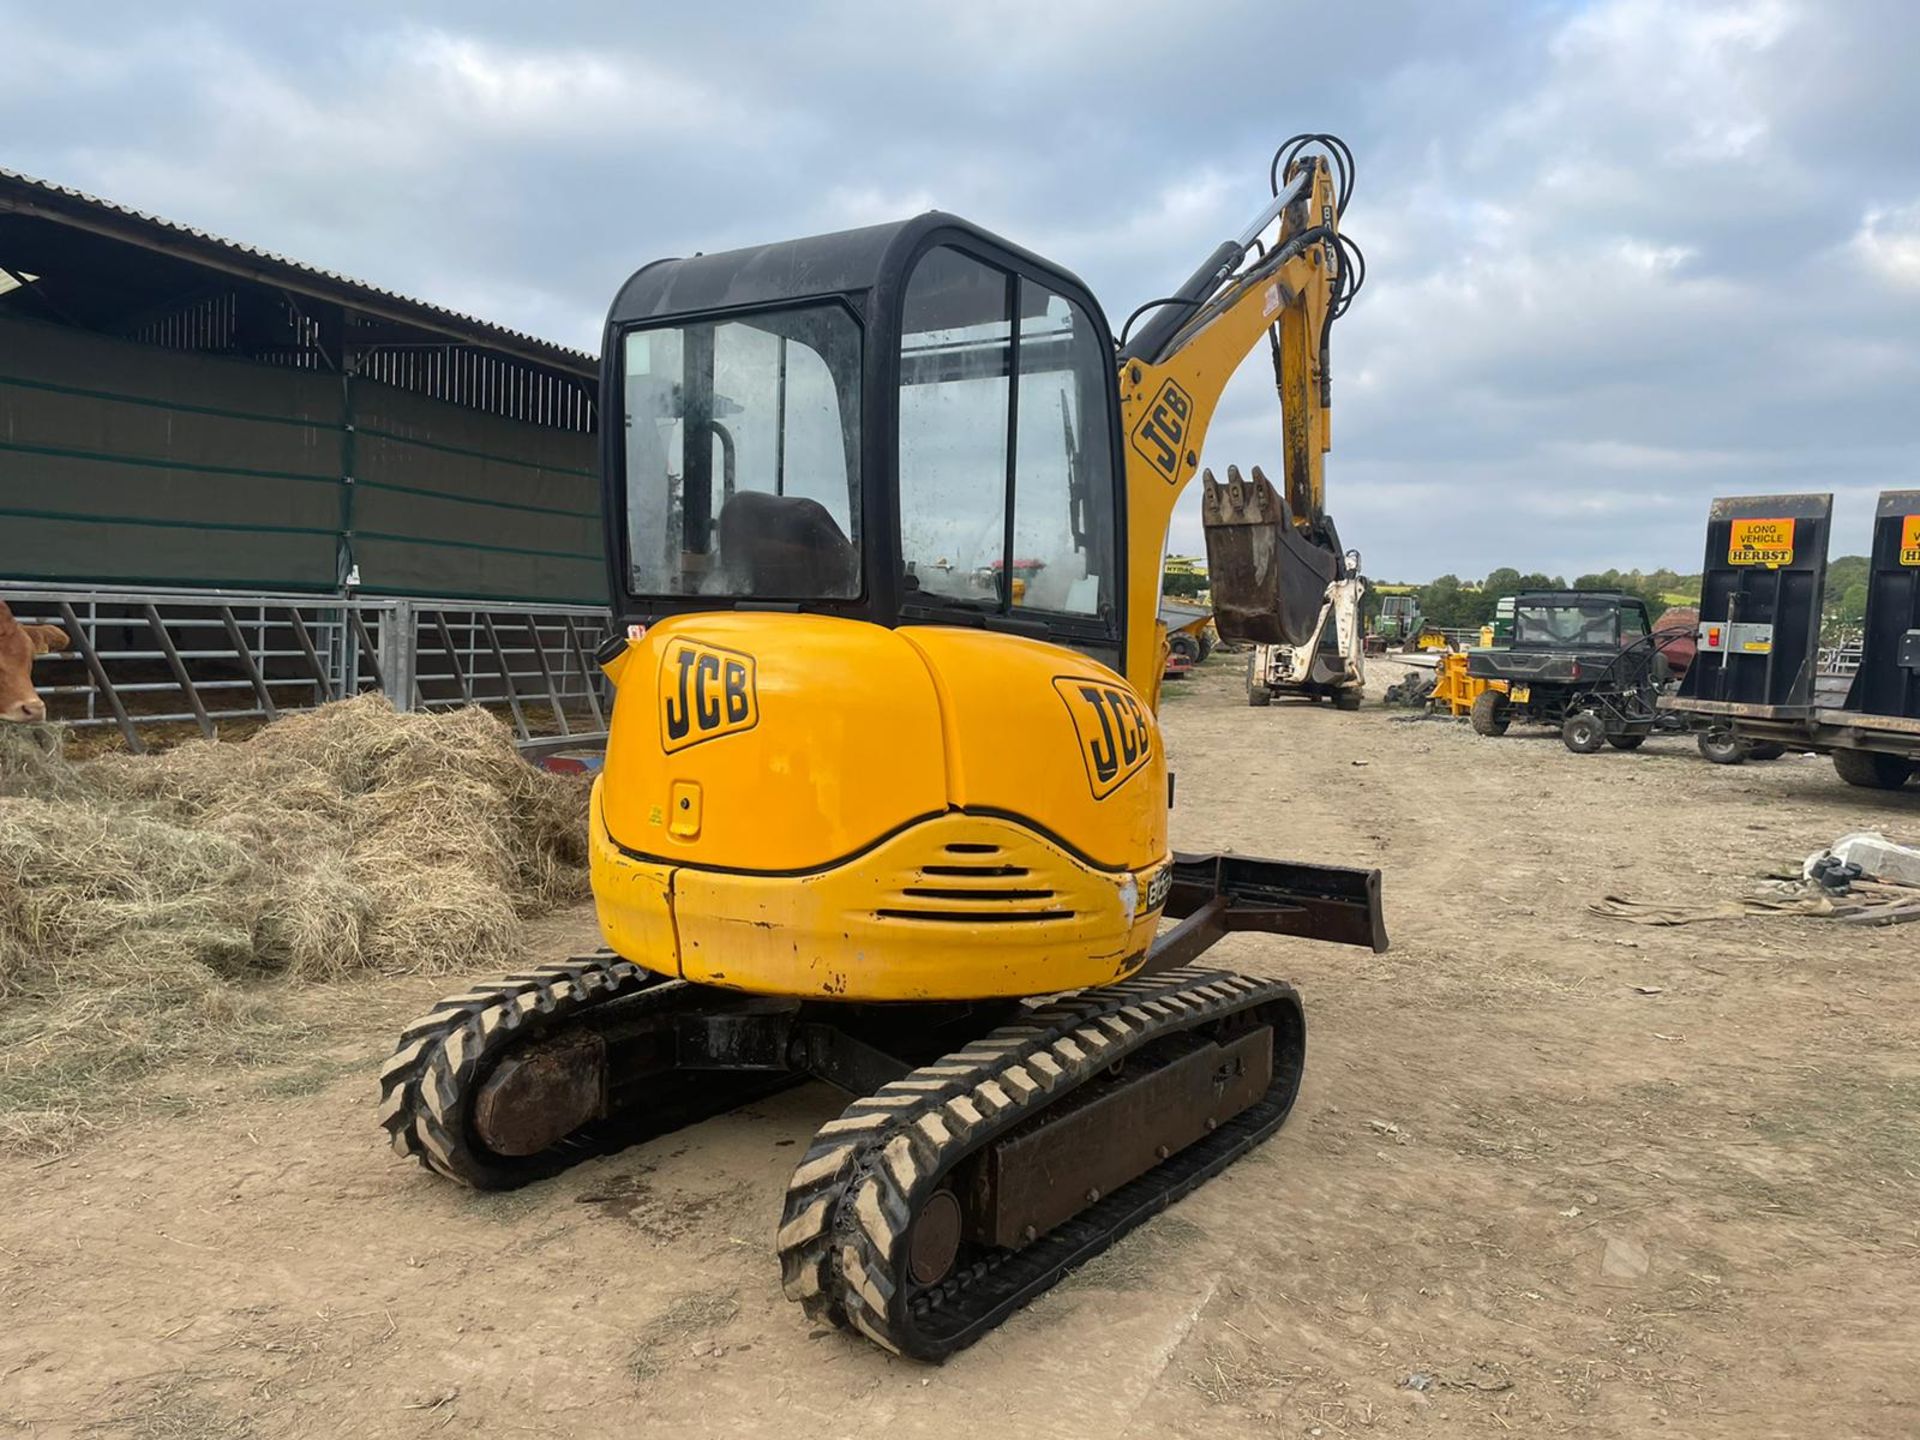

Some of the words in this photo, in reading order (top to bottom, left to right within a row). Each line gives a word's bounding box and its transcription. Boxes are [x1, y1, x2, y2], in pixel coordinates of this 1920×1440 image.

[1141, 387, 1188, 474] JCB
[1740, 534, 1784, 543] VEHICLE
[1747, 525, 1777, 534] LONG
[1732, 551, 1789, 561] HERBST
[666, 648, 749, 740] JCB
[1078, 686, 1149, 783] JCB
